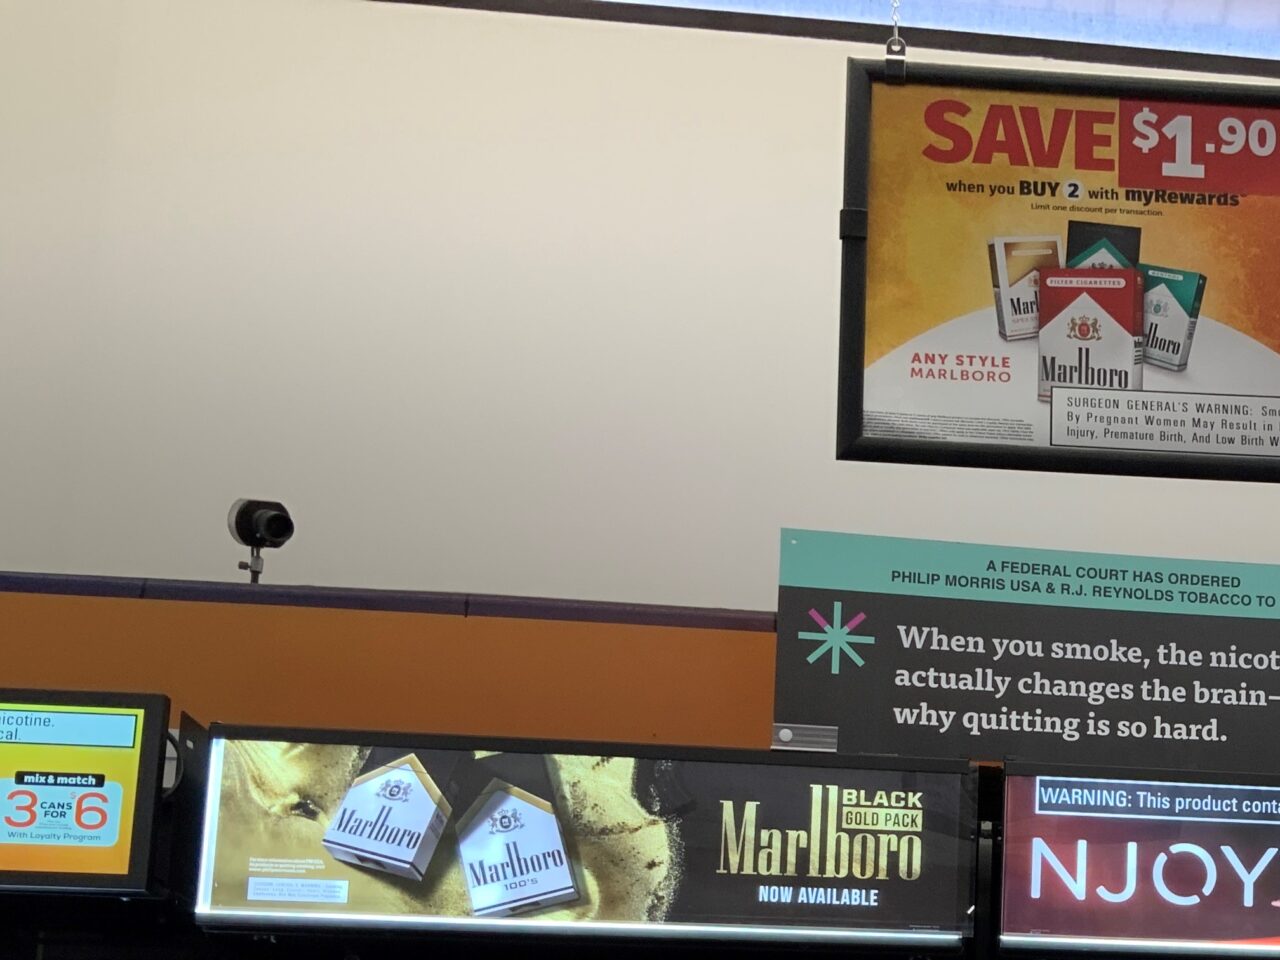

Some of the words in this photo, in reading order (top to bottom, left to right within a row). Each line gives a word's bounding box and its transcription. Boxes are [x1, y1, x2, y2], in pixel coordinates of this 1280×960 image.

[922, 99, 1116, 172] SAVE
[946, 181, 984, 193] when
[990, 184, 1015, 196] you
[1020, 181, 1060, 196] BUY
[1068, 183, 1079, 198] 2
[1088, 189, 1119, 200] with
[1126, 189, 1240, 206] myRewards
[911, 353, 948, 366] ANY
[956, 354, 1011, 368] STYLE
[1041, 347, 1129, 389] Marlboro
[911, 367, 1011, 382] MARLBORO
[1067, 397, 1120, 409] SURGEON
[1127, 401, 1188, 412] GENERAL'S
[1195, 403, 1252, 415] WARNING:
[1067, 412, 1080, 424] By
[1087, 413, 1138, 426] Pregnant
[1145, 416, 1186, 427] Women
[1192, 418, 1214, 431] May
[1221, 419, 1256, 431] Result
[1264, 420, 1272, 431] in
[1067, 427, 1098, 439] Injury,
[1104, 429, 1153, 440] Premature
[1160, 431, 1186, 443] Birth,
[1192, 432, 1210, 444] And
[1216, 434, 1235, 444] Low
[1241, 435, 1264, 446] Birth
[986, 560, 997, 571] A
[1002, 561, 1071, 577] FEDERAL
[1076, 566, 1128, 581] COURT
[1133, 571, 1163, 583] HAS
[1168, 573, 1240, 588] ORDERED
[892, 570, 940, 585] PHILIP
[945, 575, 1005, 590] MORRIS
[1011, 580, 1041, 592] USA
[1046, 583, 1055, 594] &
[1061, 584, 1087, 596] R.J.
[1092, 585, 1174, 601] REYNOLDS
[1179, 591, 1251, 606] TOBACCO
[1256, 596, 1276, 607] TO
[897, 625, 985, 653] When
[992, 638, 1044, 661] you
[1051, 639, 1150, 669] smoke,
[1157, 642, 1202, 666] the
[895, 668, 1011, 698] actually
[1018, 672, 1134, 705] changes
[1141, 679, 1186, 702] the
[893, 702, 956, 733] why
[962, 707, 1080, 741] quitting
[1087, 712, 1110, 736] is
[1117, 719, 1147, 738] so
[1153, 716, 1227, 741] hard.
[57, 776, 96, 785] match
[4, 790, 38, 828] 3
[40, 802, 72, 810] CANS
[842, 790, 922, 809] BLACK
[1041, 787, 1132, 807] WARNING:
[1137, 792, 1170, 809] This
[1176, 794, 1238, 813] product
[44, 810, 66, 818] FOR
[846, 811, 880, 829] GOLD
[884, 812, 919, 829] PACK
[332, 805, 422, 850] Marlboro
[716, 784, 922, 881] Marlboro
[1031, 837, 1278, 907] NJOY
[759, 887, 791, 903] NOW
[798, 888, 879, 906] AVAILABLE
